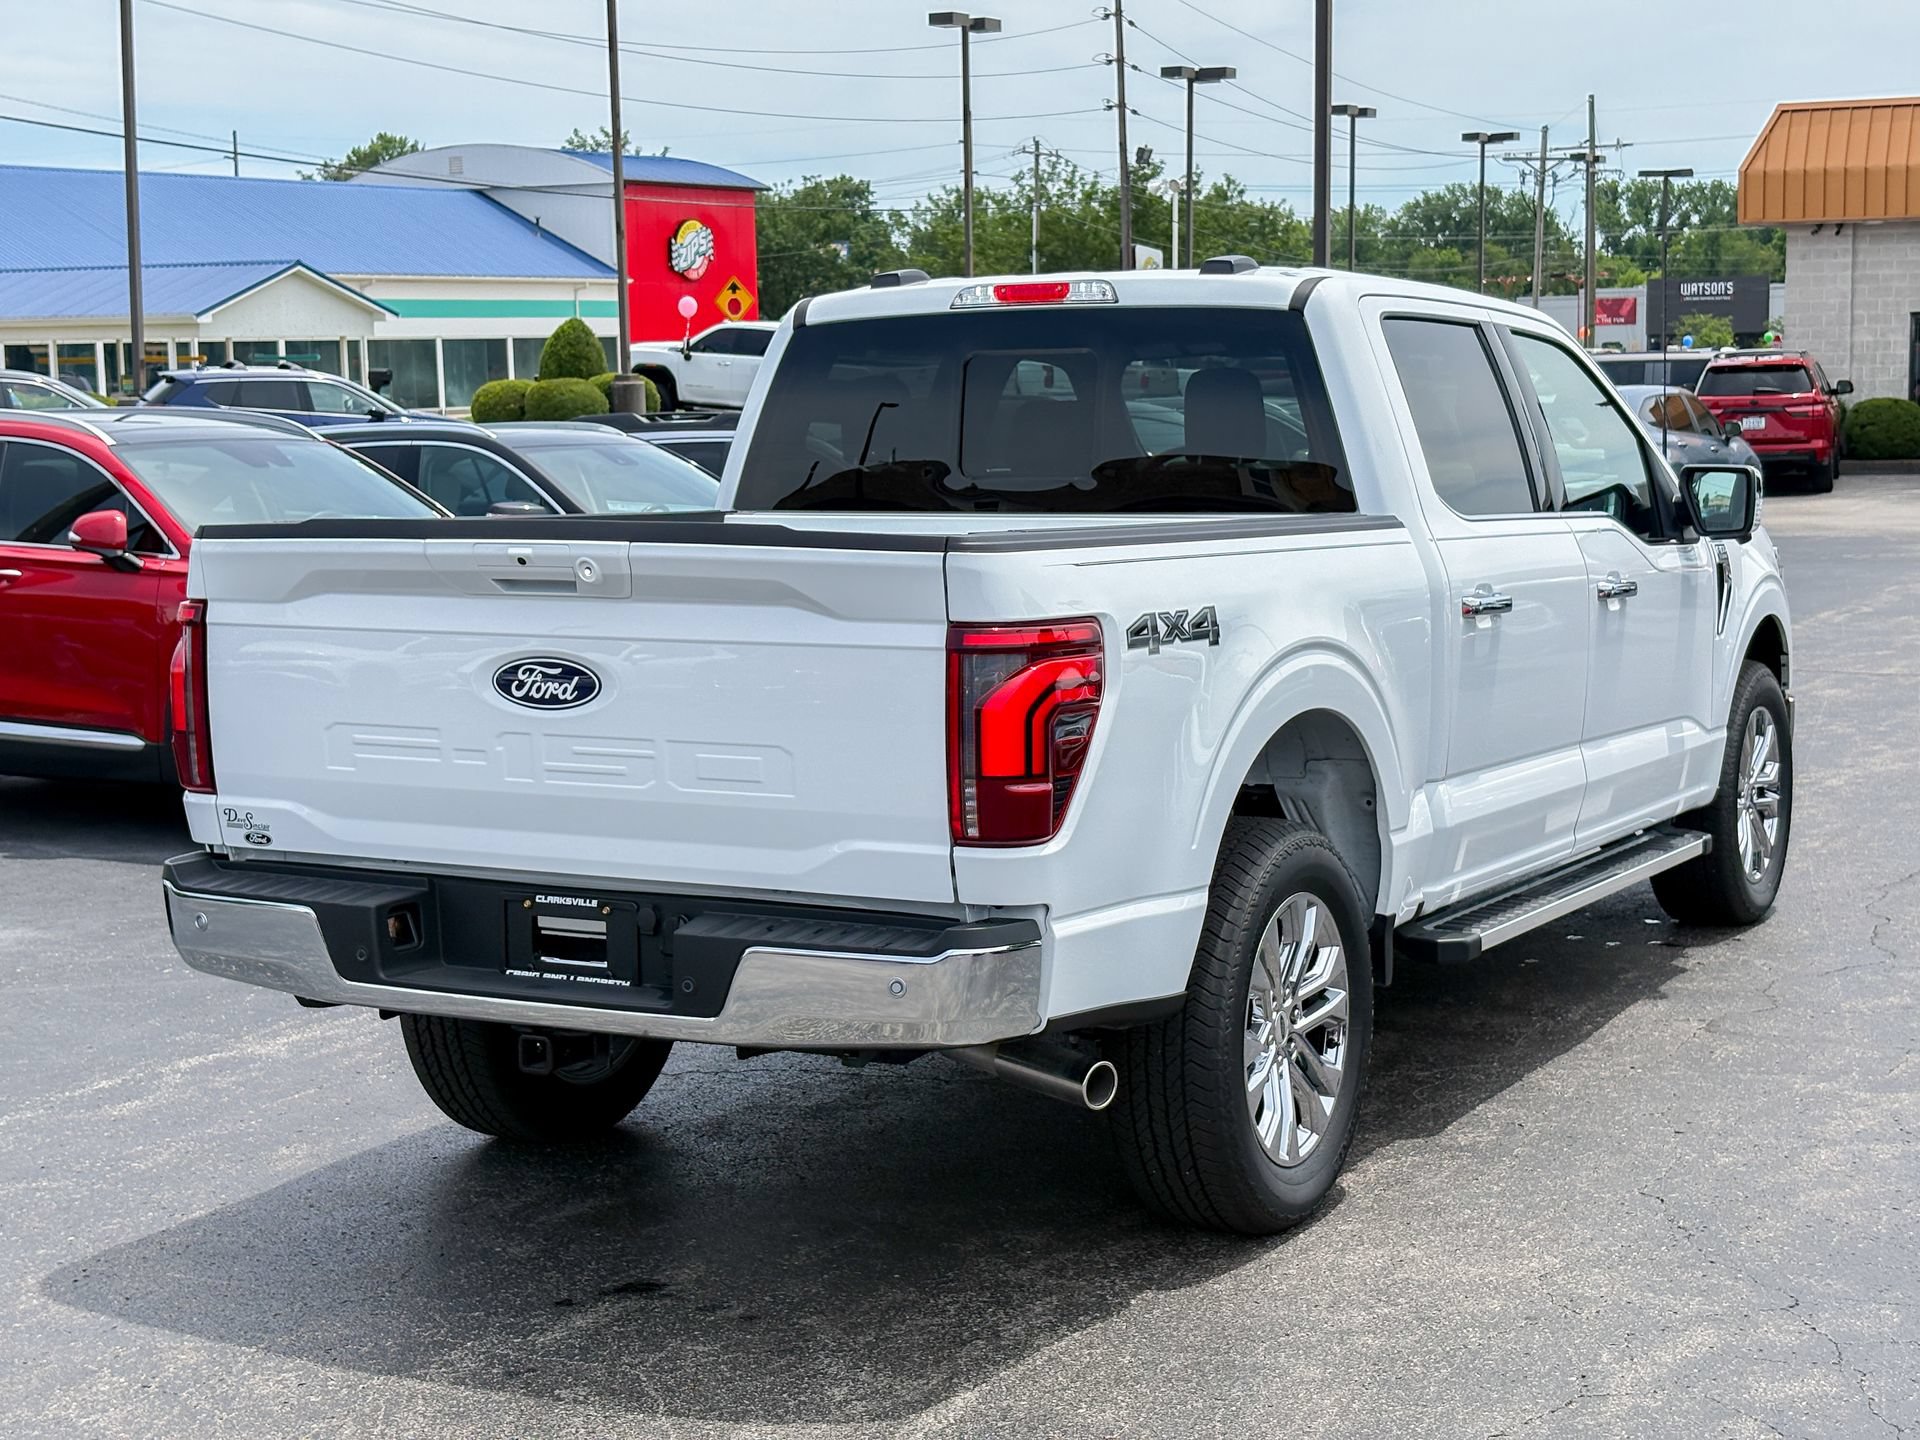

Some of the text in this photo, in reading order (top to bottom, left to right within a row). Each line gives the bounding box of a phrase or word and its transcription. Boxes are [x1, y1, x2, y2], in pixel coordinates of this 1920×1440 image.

[678, 231, 708, 268] ZIPS
[1680, 281, 1734, 296] WATSON'S
[511, 664, 580, 701] Ford
[324, 721, 795, 797] F-150
[249, 833, 268, 844] Ford
[535, 895, 598, 908] CLARKSVILLE
